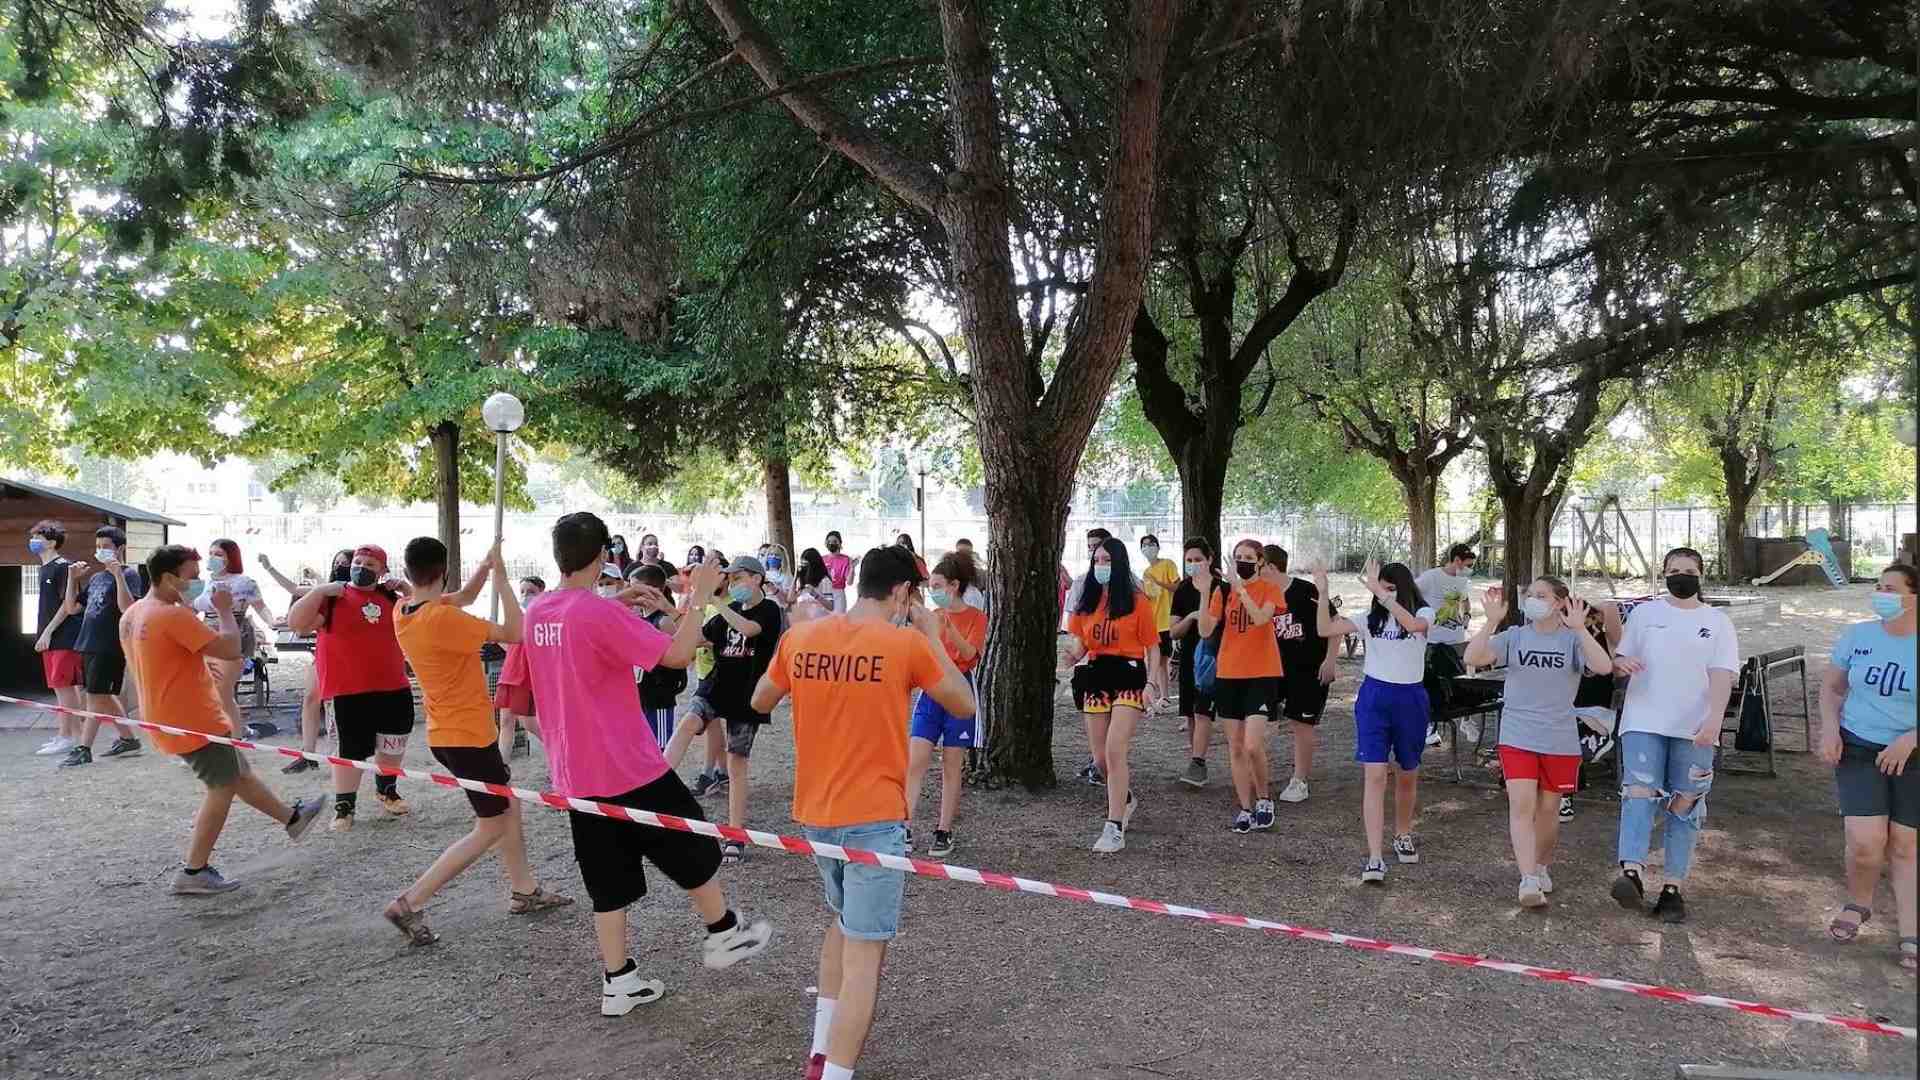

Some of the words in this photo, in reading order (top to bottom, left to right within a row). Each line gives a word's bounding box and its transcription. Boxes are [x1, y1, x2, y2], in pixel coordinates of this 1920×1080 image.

[534, 623, 563, 647] GIFT
[793, 652, 884, 682] SERVICE
[1518, 650, 1565, 669] VANS
[1864, 661, 1911, 697] GOL
